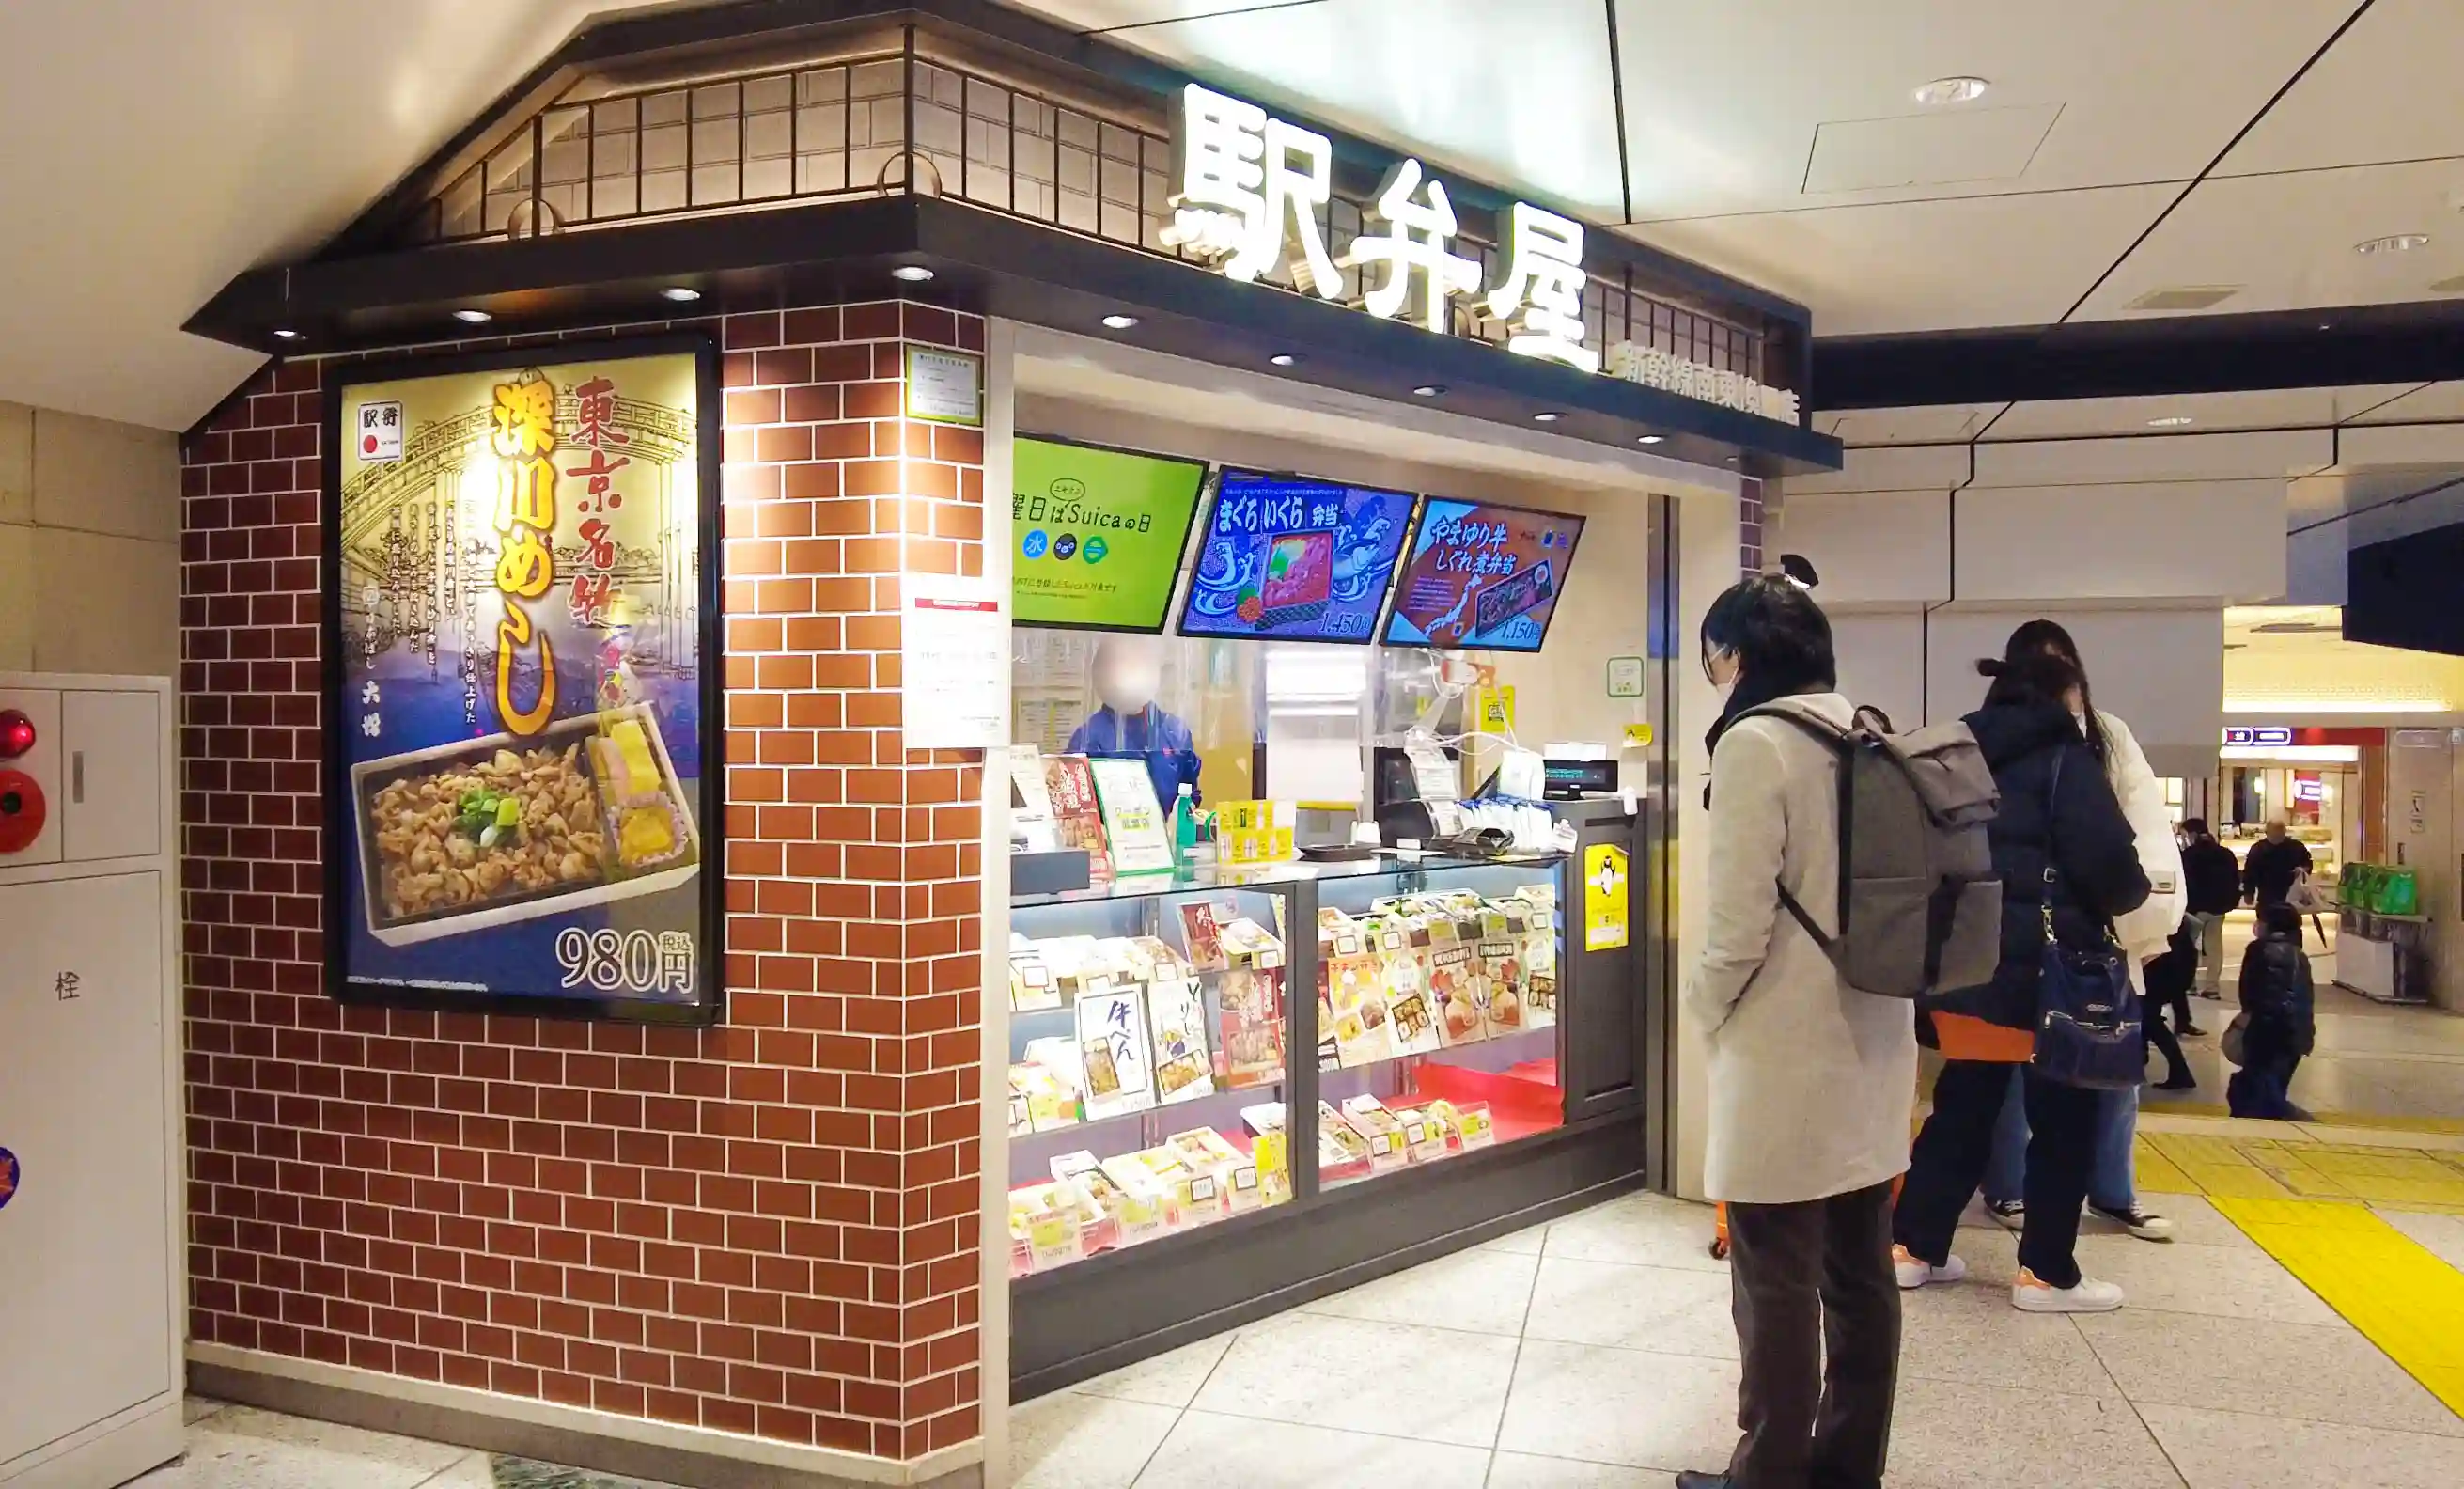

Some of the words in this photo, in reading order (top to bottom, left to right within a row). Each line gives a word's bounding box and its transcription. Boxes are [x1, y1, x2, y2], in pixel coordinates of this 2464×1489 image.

[1159, 83, 1599, 373] 駅弁屋
[1026, 536, 1044, 554] 水
[1431, 516, 1508, 552] やまゆり牛
[493, 378, 556, 736] 深川めし
[1436, 549, 1518, 576] しぐれ煮弁当
[555, 927, 695, 994] 980円
[55, 971, 80, 1001] 栓
